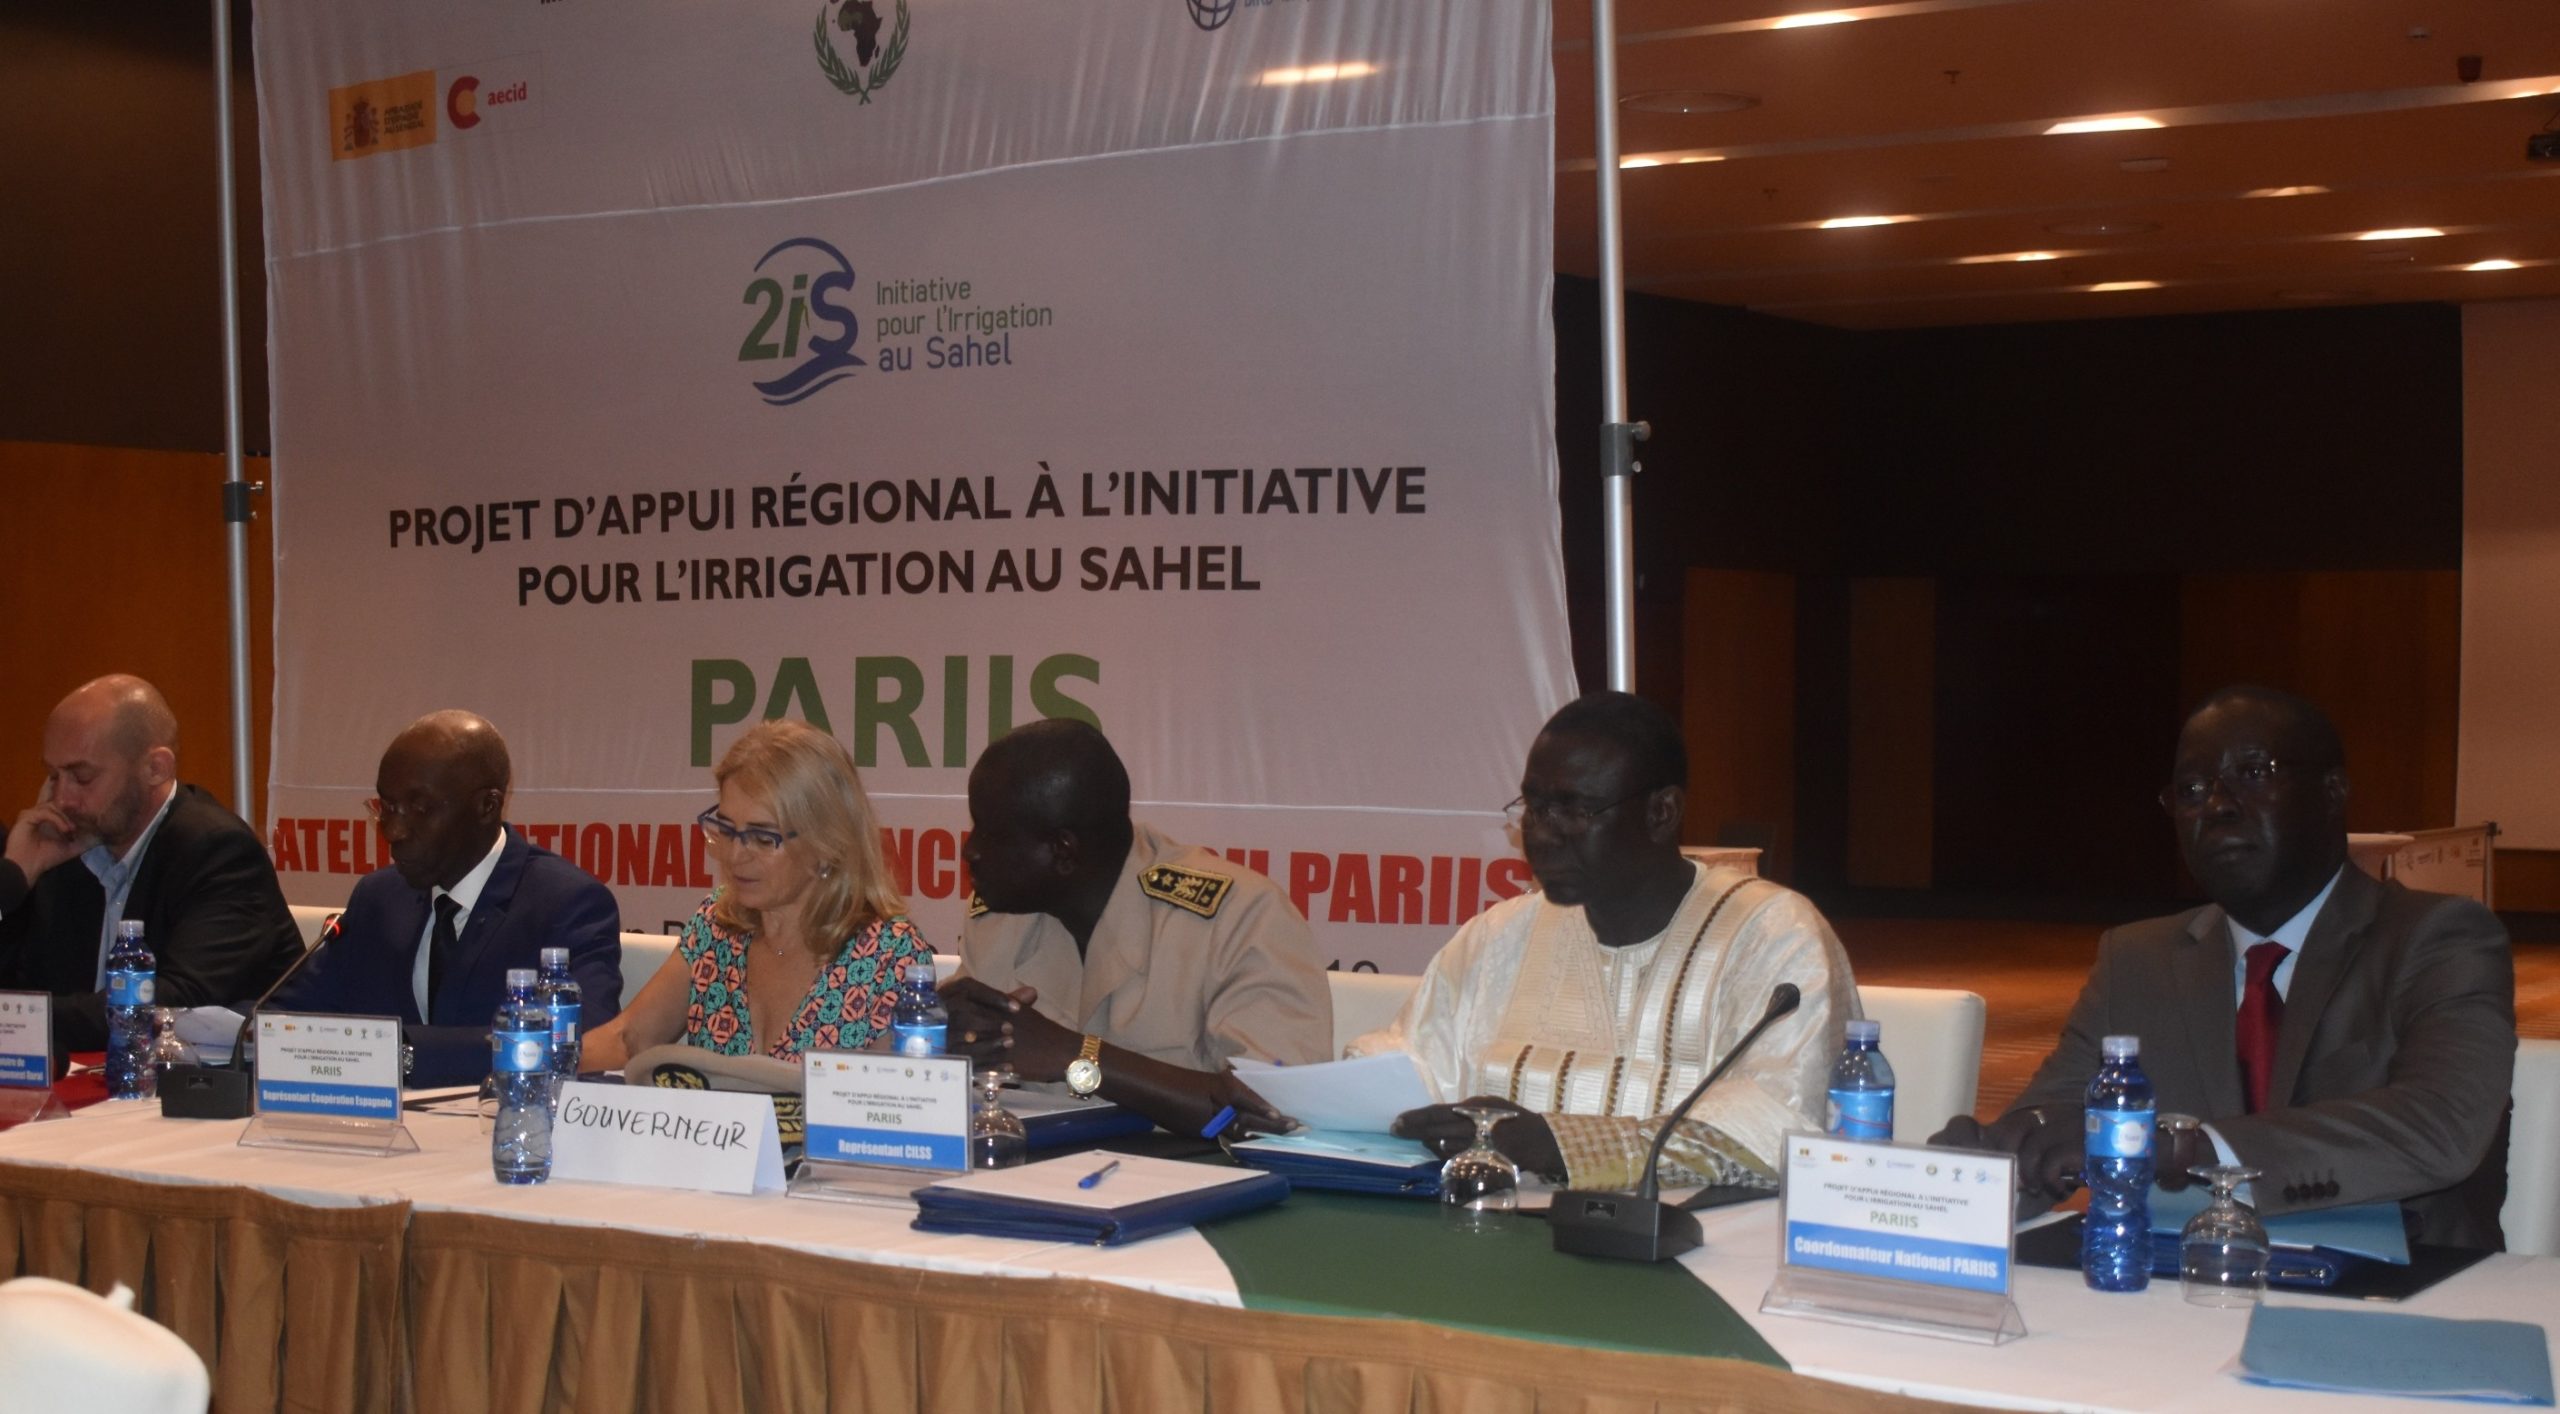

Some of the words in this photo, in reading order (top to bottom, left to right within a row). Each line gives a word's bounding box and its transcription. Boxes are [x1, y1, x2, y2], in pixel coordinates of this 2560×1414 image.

[487, 82, 528, 106] aecid
[876, 277, 972, 305] Initiative
[877, 314, 926, 343] pour
[936, 302, 1054, 336] l'Irrigation
[879, 345, 913, 373] au
[926, 332, 1013, 369] Sahel
[389, 499, 541, 554] PROJET
[554, 487, 735, 539] D'APPUI
[751, 472, 1012, 529] RÉGIONAL
[1025, 461, 1065, 519] À
[1082, 466, 1427, 518] L'INITIATIVE
[518, 562, 642, 606] POUR
[655, 549, 974, 602] L'IRRIGATION
[985, 547, 1062, 593] AU
[1080, 544, 1261, 592] SAHEL
[690, 652, 1103, 769] PARIIS
[273, 818, 390, 876] ATELI
[311, 1065, 342, 1077] PARIIS
[563, 1096, 749, 1151] GOUVERNEUR
[866, 1111, 903, 1125] PARIIS
[904, 1144, 933, 1160] CILSS
[1869, 1210, 1919, 1229] PARIIS
[1794, 1235, 1894, 1265] Coordonnateur
[1894, 1248, 1951, 1273] National
[1952, 1256, 1999, 1278] PARIIS
